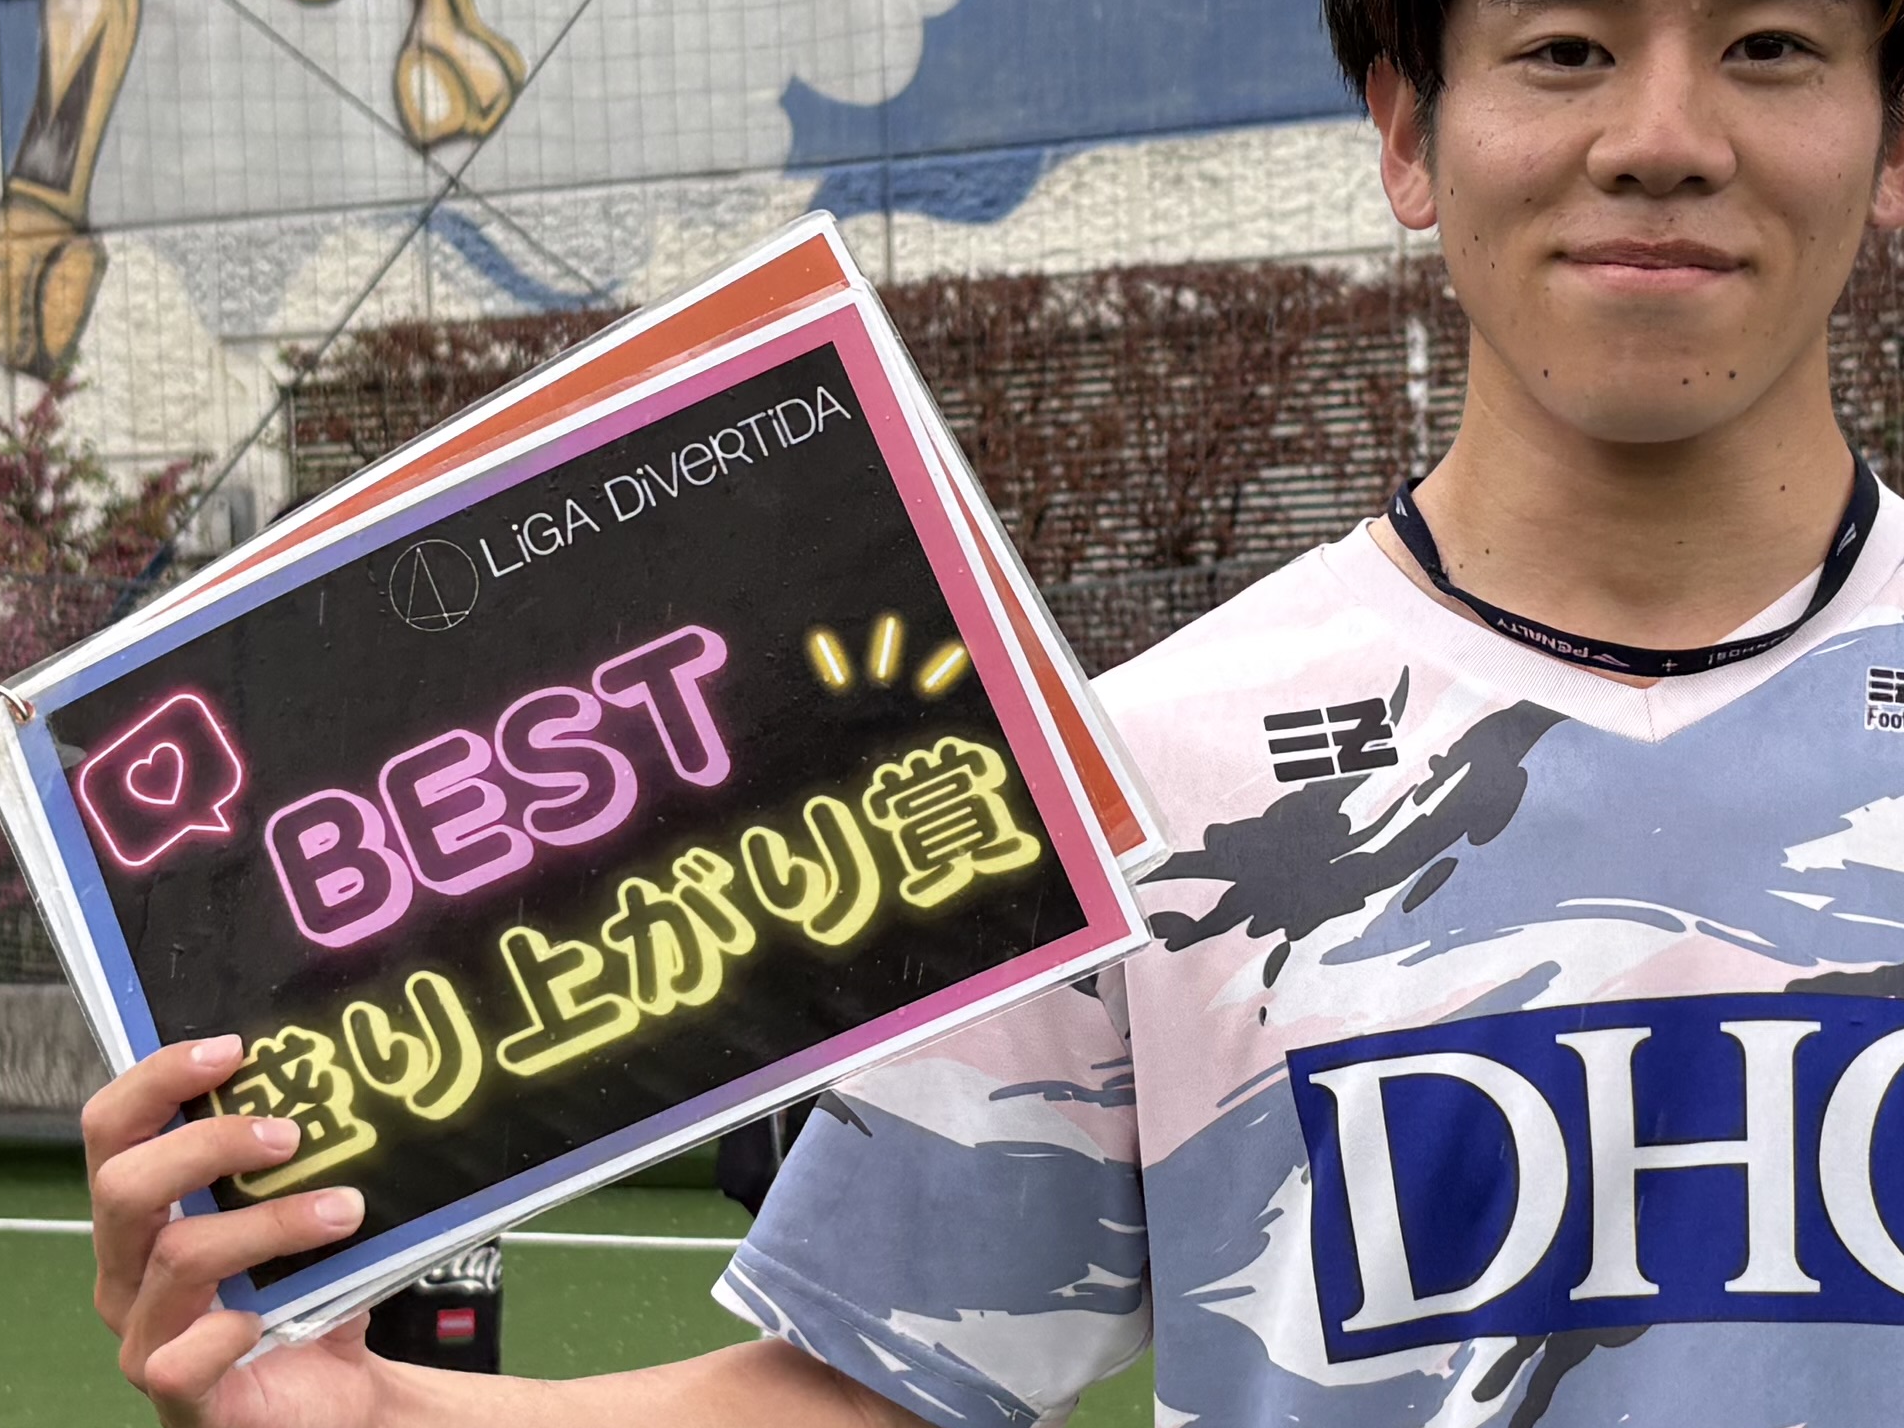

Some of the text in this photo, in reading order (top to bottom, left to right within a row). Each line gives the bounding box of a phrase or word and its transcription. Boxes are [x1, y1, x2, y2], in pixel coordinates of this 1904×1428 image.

[209, 736, 1042, 1198] 盛り上がり賞
[264, 624, 731, 948] BEST
